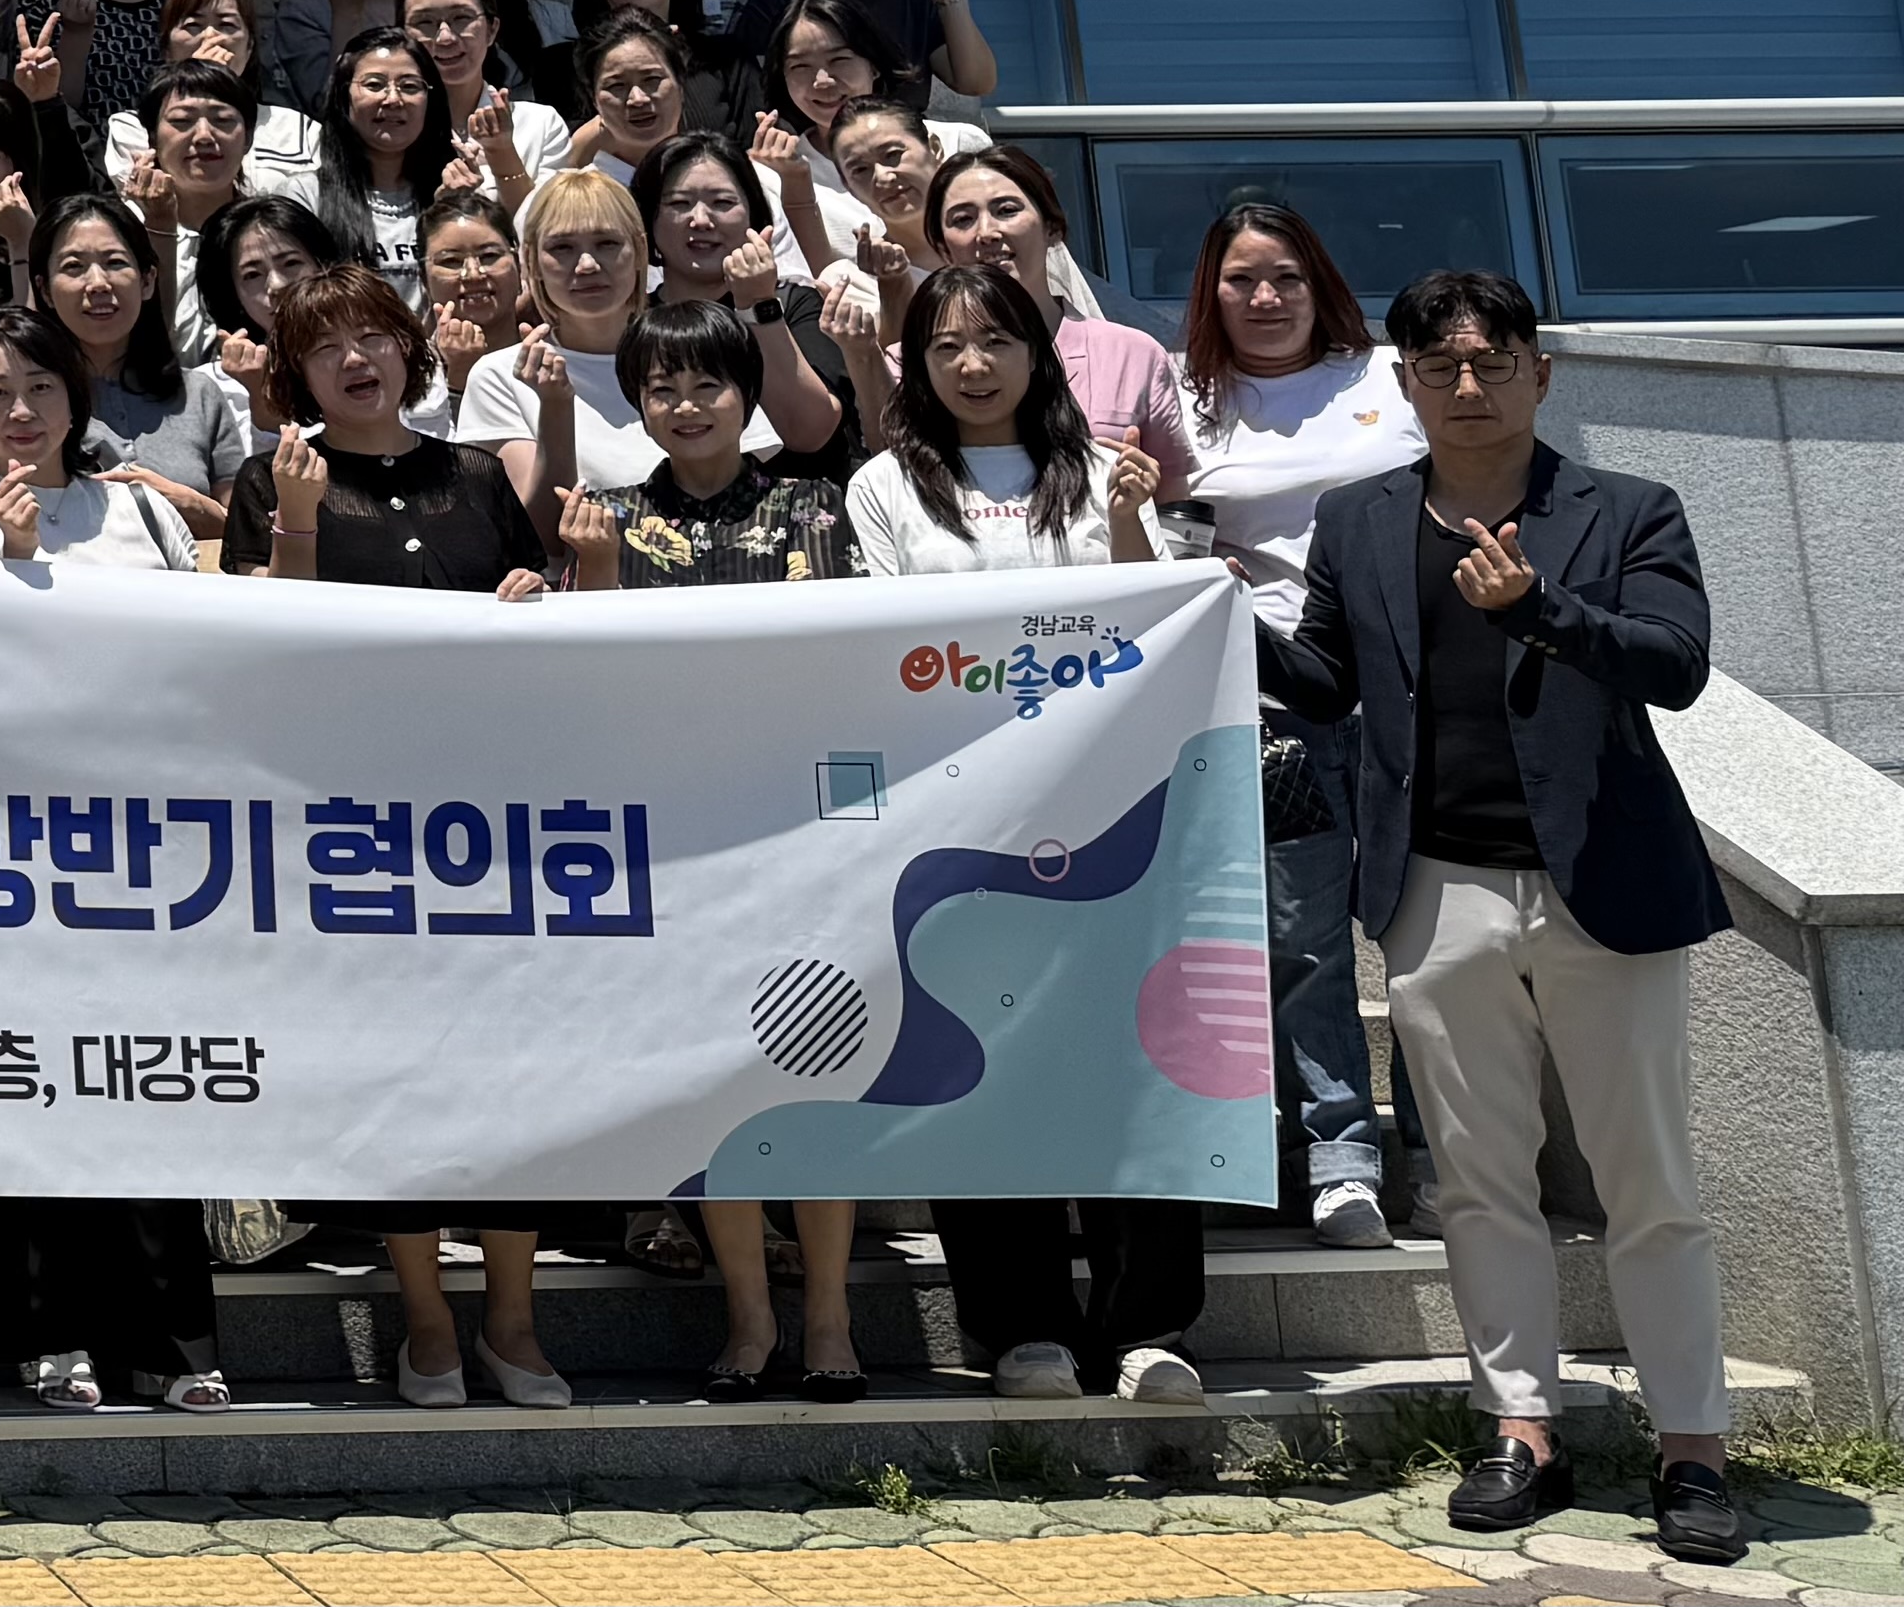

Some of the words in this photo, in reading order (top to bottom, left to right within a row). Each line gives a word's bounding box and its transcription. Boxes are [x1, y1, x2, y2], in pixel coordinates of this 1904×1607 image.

[1020, 615, 1097, 637] 경남교육
[899, 638, 1145, 721] 아이좋아
[304, 796, 655, 938] 협의회
[72, 1034, 265, 1104] 대강당
